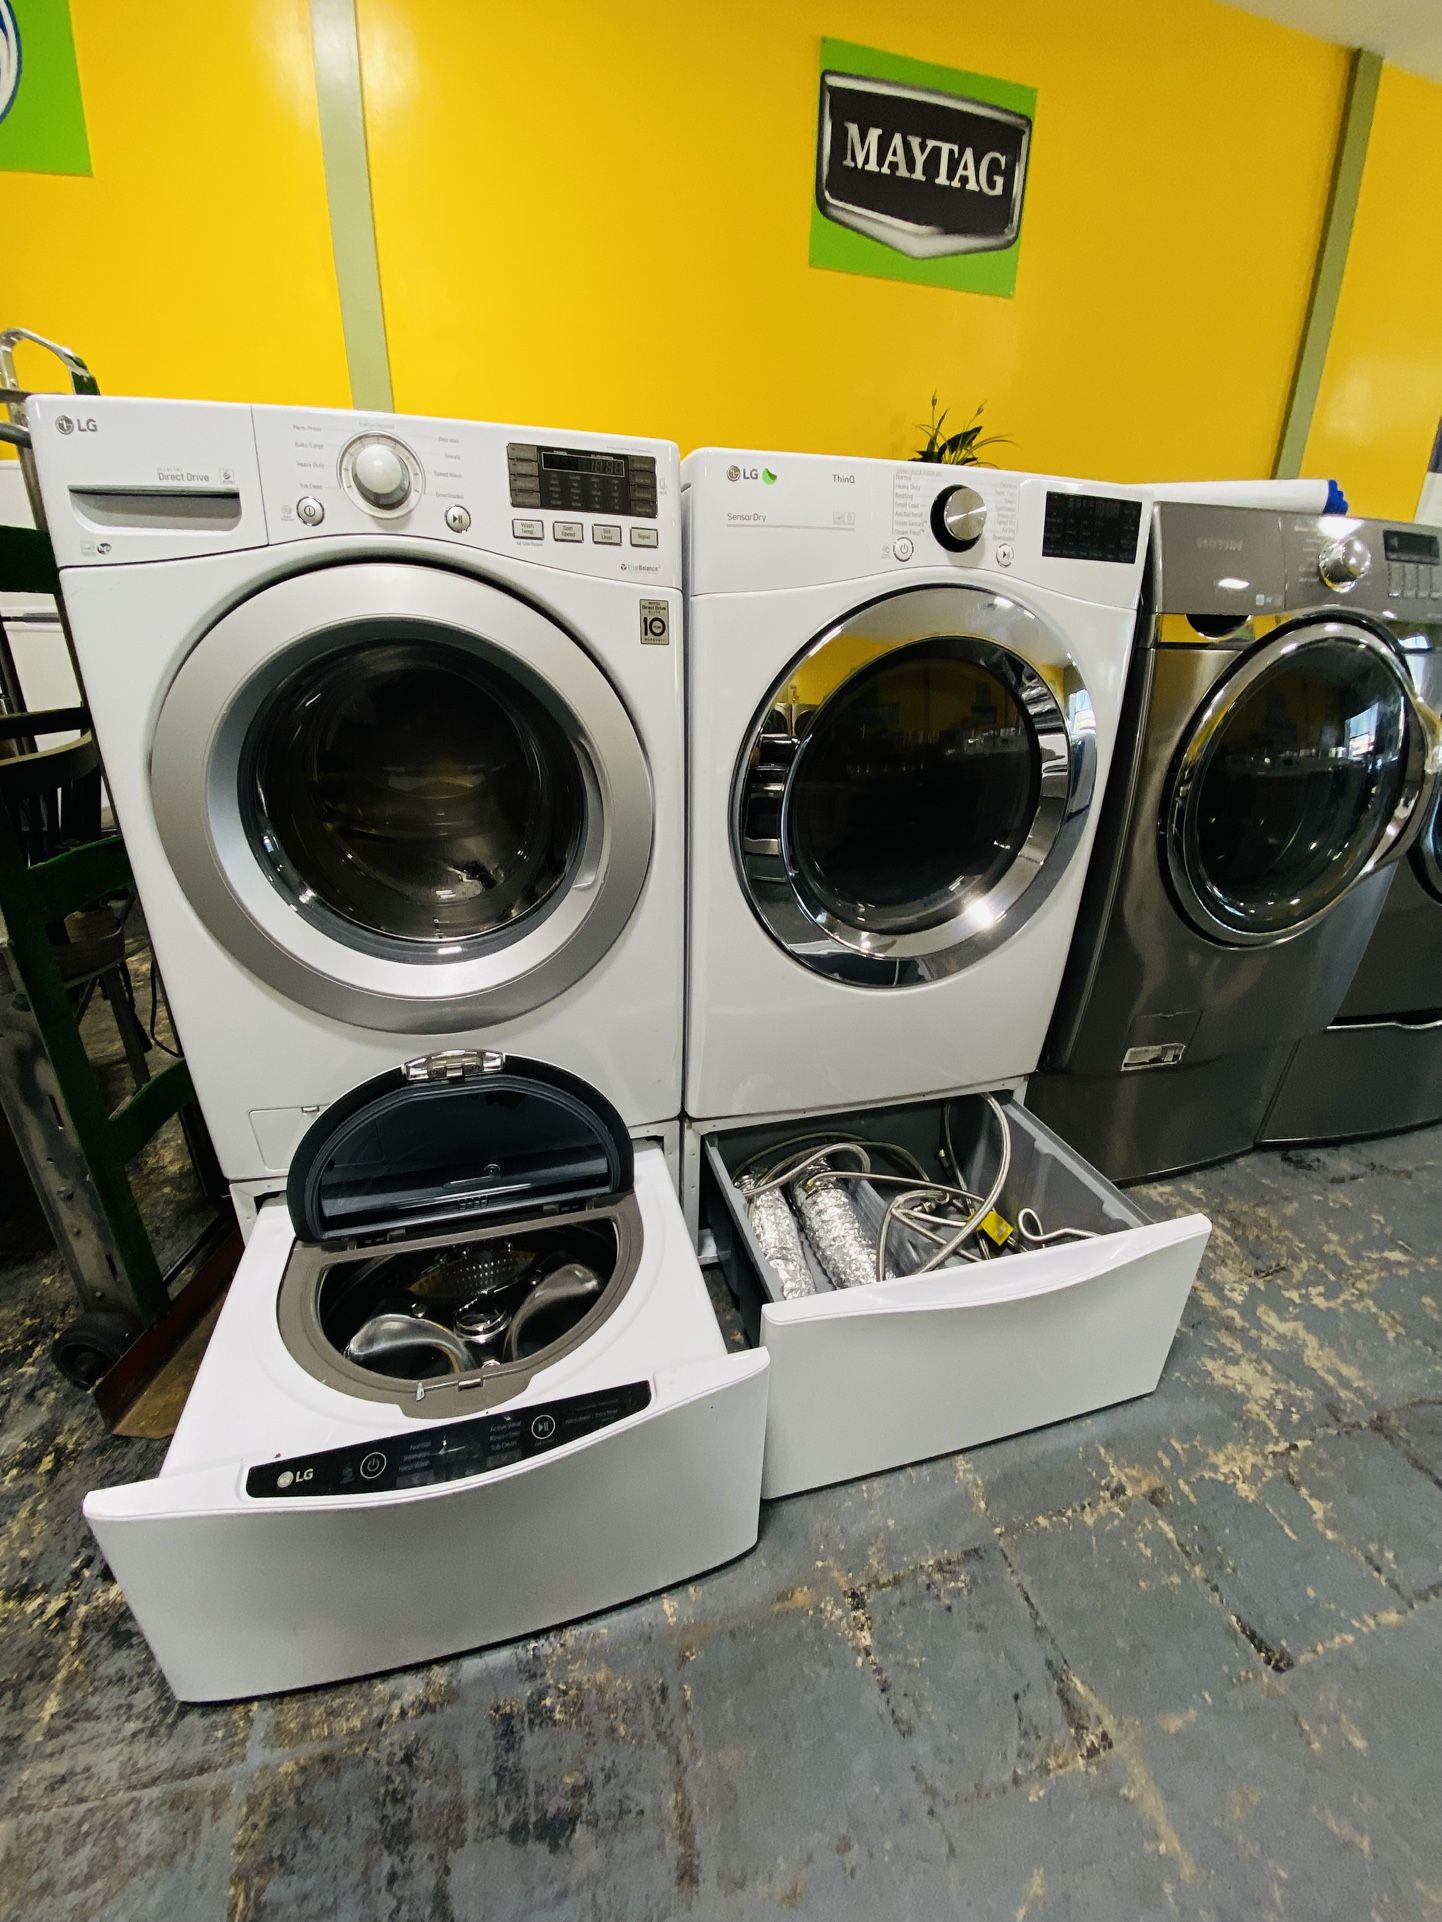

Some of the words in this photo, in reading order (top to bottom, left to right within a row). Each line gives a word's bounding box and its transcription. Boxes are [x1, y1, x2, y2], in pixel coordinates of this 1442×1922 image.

[842, 121, 1006, 196] MAYTAG
[77, 418, 98, 433] LG
[158, 472, 184, 482] Direct
[186, 473, 210, 482] Drive
[743, 468, 759, 480] LG
[832, 474, 855, 484] ThinQ
[643, 617, 666, 637] 10
[296, 1467, 315, 1484] LG
